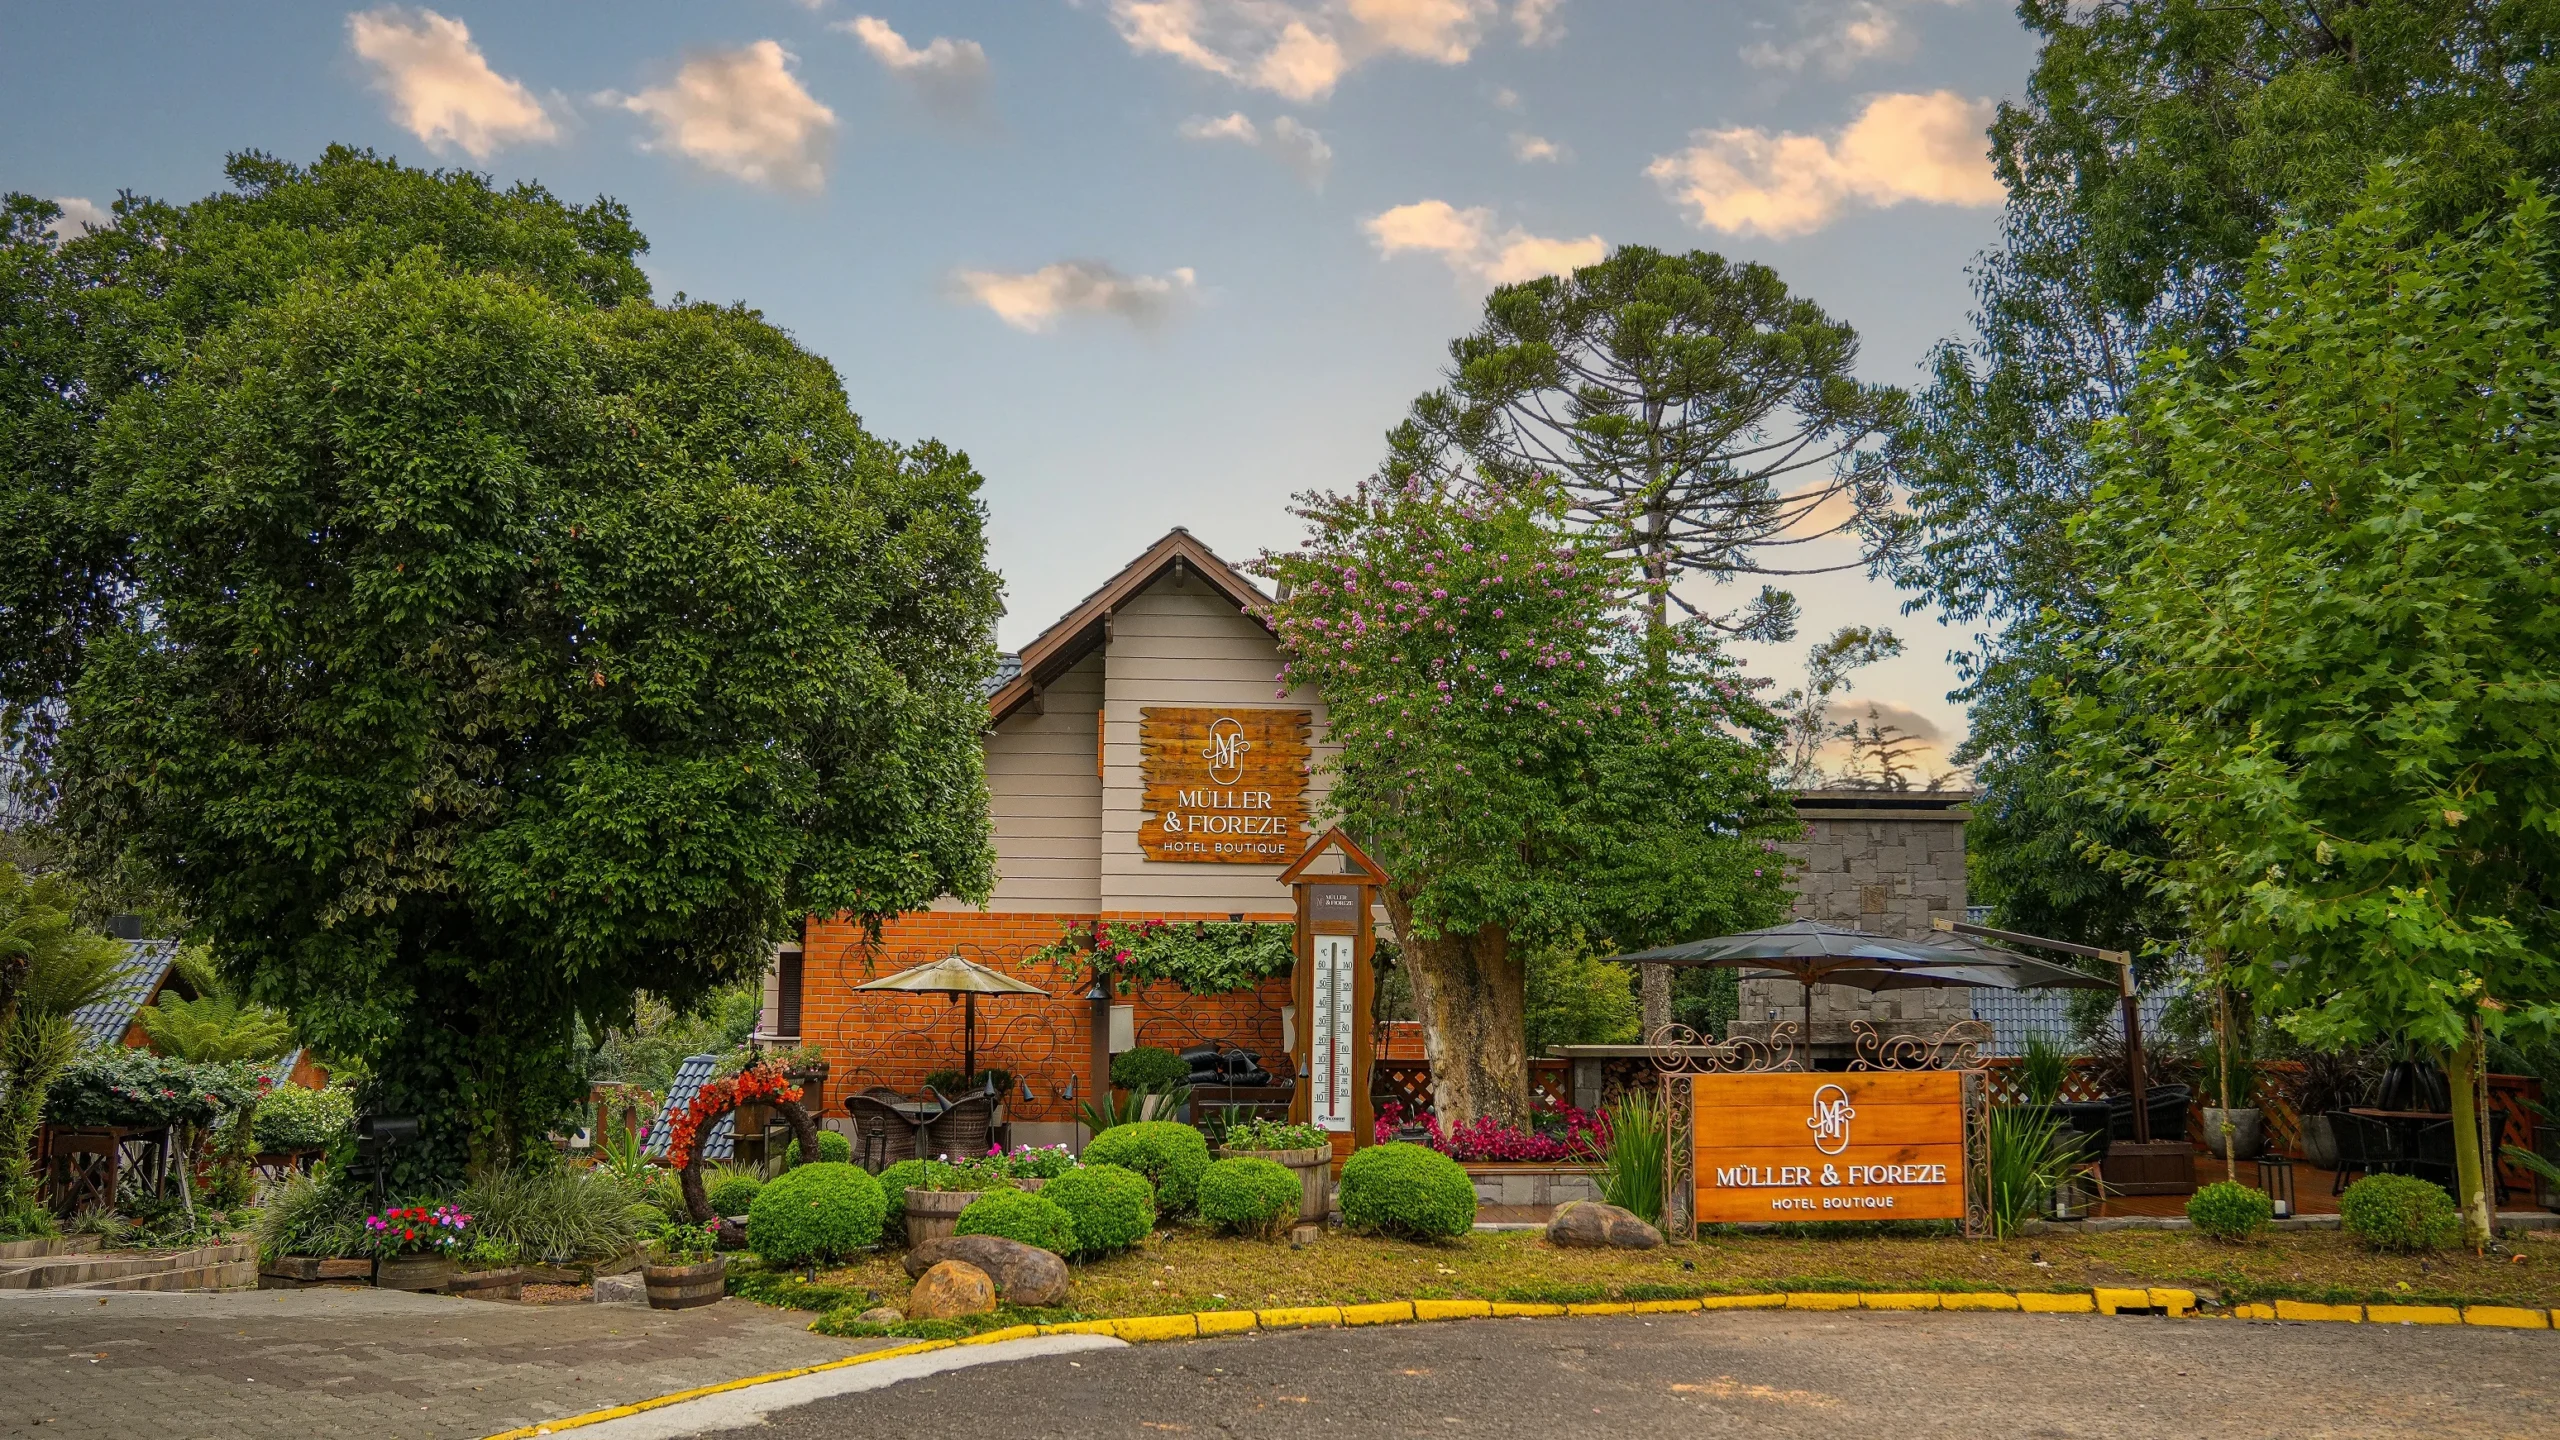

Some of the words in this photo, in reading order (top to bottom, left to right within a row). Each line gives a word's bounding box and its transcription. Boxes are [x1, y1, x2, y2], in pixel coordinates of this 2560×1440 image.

[1178, 788, 1272, 809] MÜLLER
[1163, 811, 1183, 833] &
[1188, 815, 1287, 835] FIOREZE
[1164, 842, 1207, 852] HOTEL
[1215, 843, 1285, 854] BOUTIQUE
[1342, 961, 1353, 969] 140
[1319, 979, 1327, 988] 50
[1342, 1003, 1352, 1012] 100
[1341, 1023, 1350, 1032] 80
[1341, 1045, 1350, 1053] 60
[1318, 1055, 1326, 1063] 10
[1340, 1066, 1349, 1074] 40
[1317, 1074, 1323, 1082] 0
[1340, 1088, 1349, 1096] 20
[1716, 1164, 1812, 1187] MÜLLER
[1820, 1163, 1840, 1186] &
[1848, 1165, 1946, 1184] FIOREZE
[1772, 1199, 1816, 1209] HOTEL
[1823, 1197, 1894, 1209] BOUTIQUE
